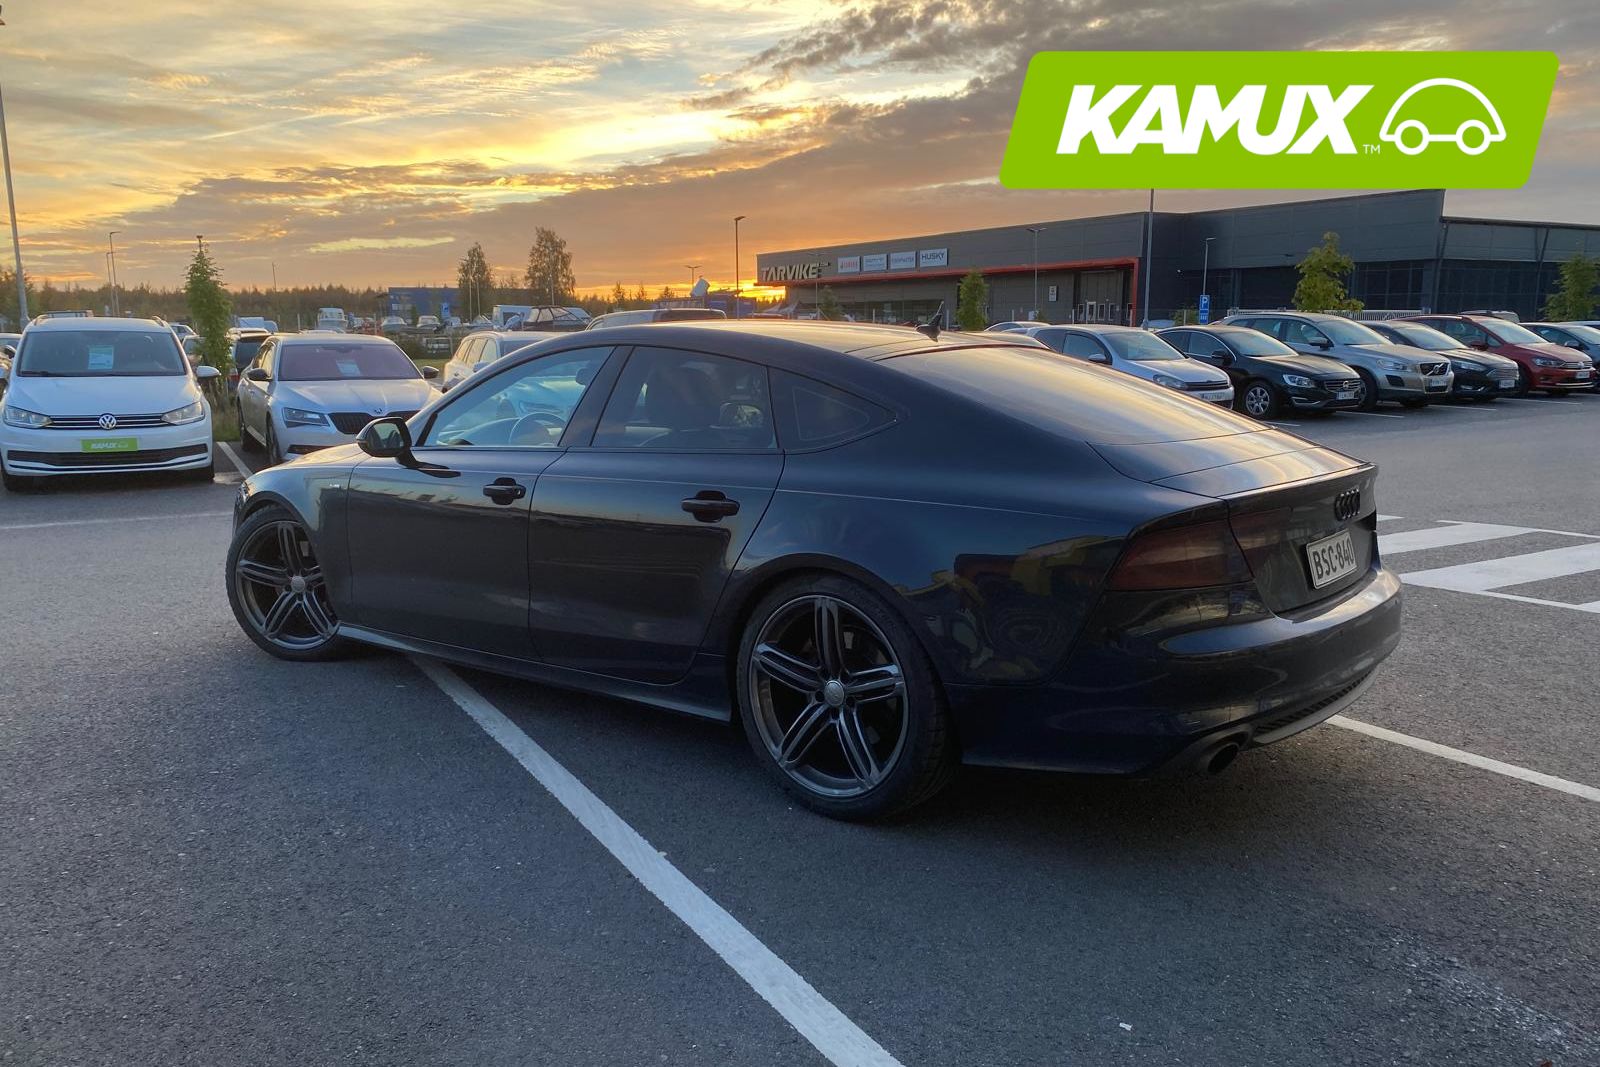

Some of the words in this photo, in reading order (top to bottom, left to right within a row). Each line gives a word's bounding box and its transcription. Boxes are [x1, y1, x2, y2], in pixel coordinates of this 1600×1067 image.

[921, 251, 945, 261] HUSKY
[761, 263, 818, 281] TARVIKE
[1201, 296, 1208, 309] P
[1312, 537, 1355, 580] BSC-840
